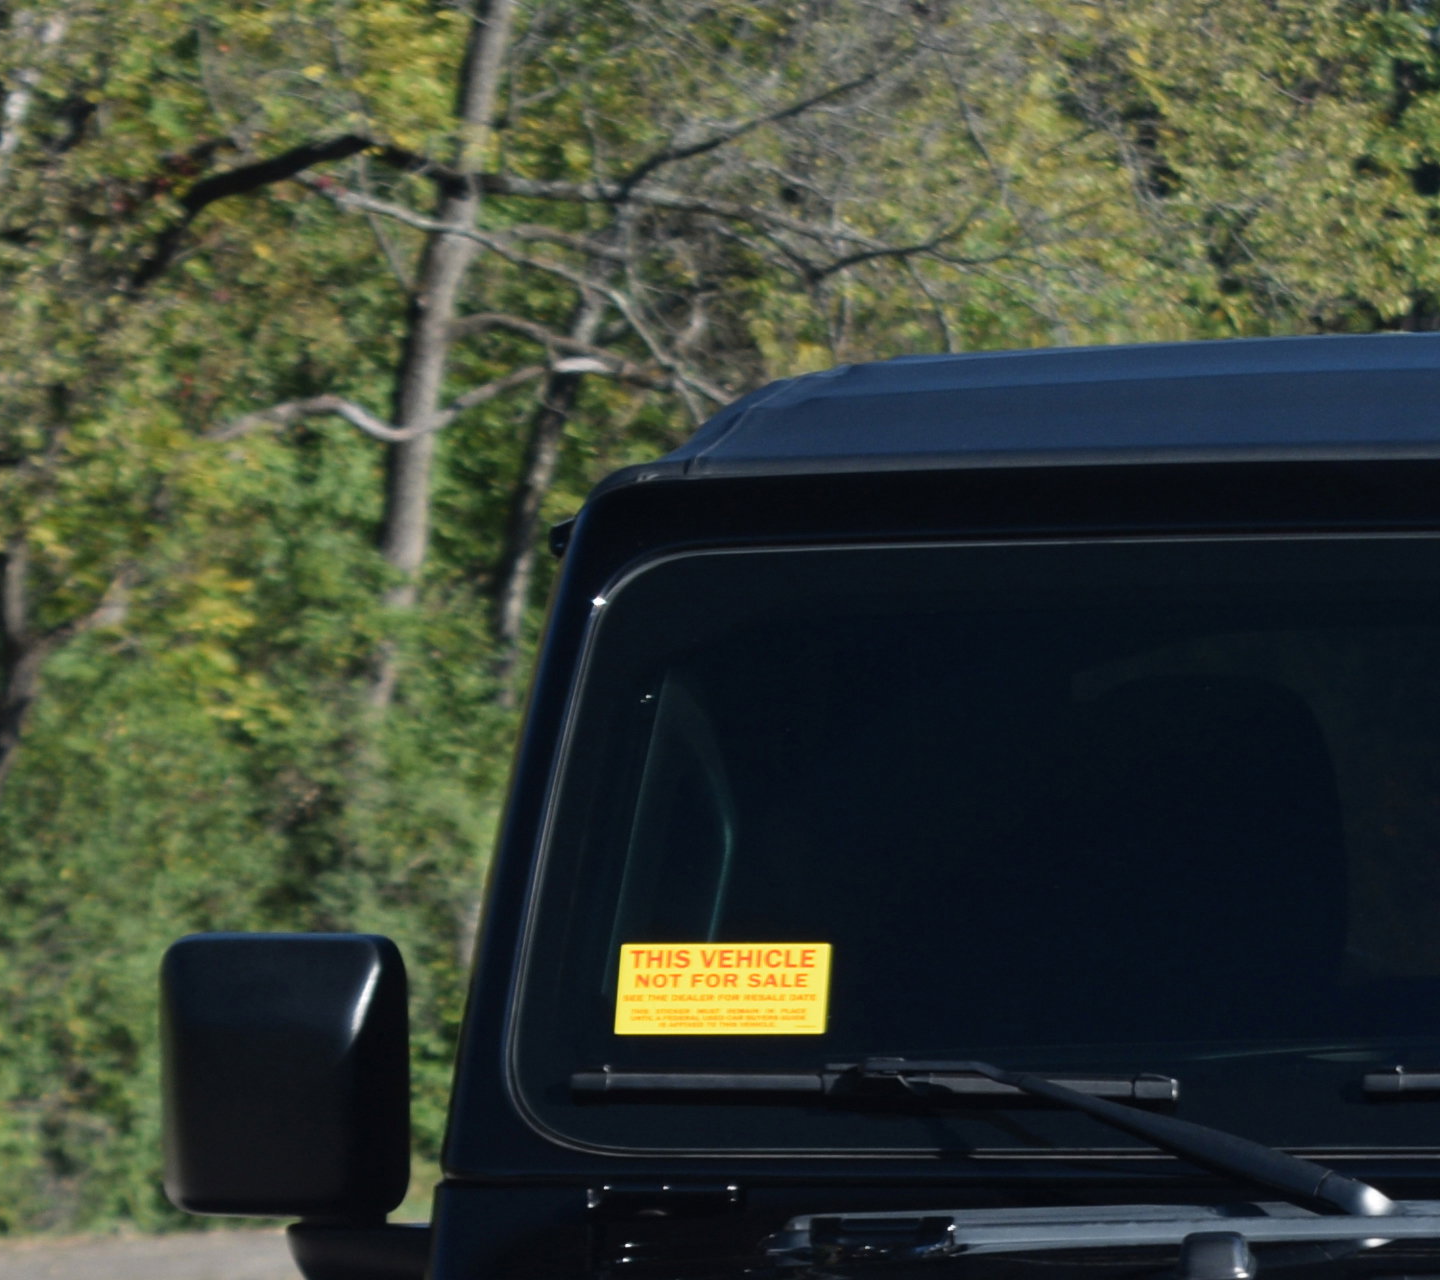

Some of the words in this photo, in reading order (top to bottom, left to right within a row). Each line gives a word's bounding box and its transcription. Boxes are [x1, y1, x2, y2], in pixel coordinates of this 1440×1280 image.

[630, 950, 690, 968] THIS
[700, 950, 816, 968] VEHICLE
[635, 974, 682, 988] NOT
[691, 974, 738, 988] FOR
[748, 974, 808, 988] SALE
